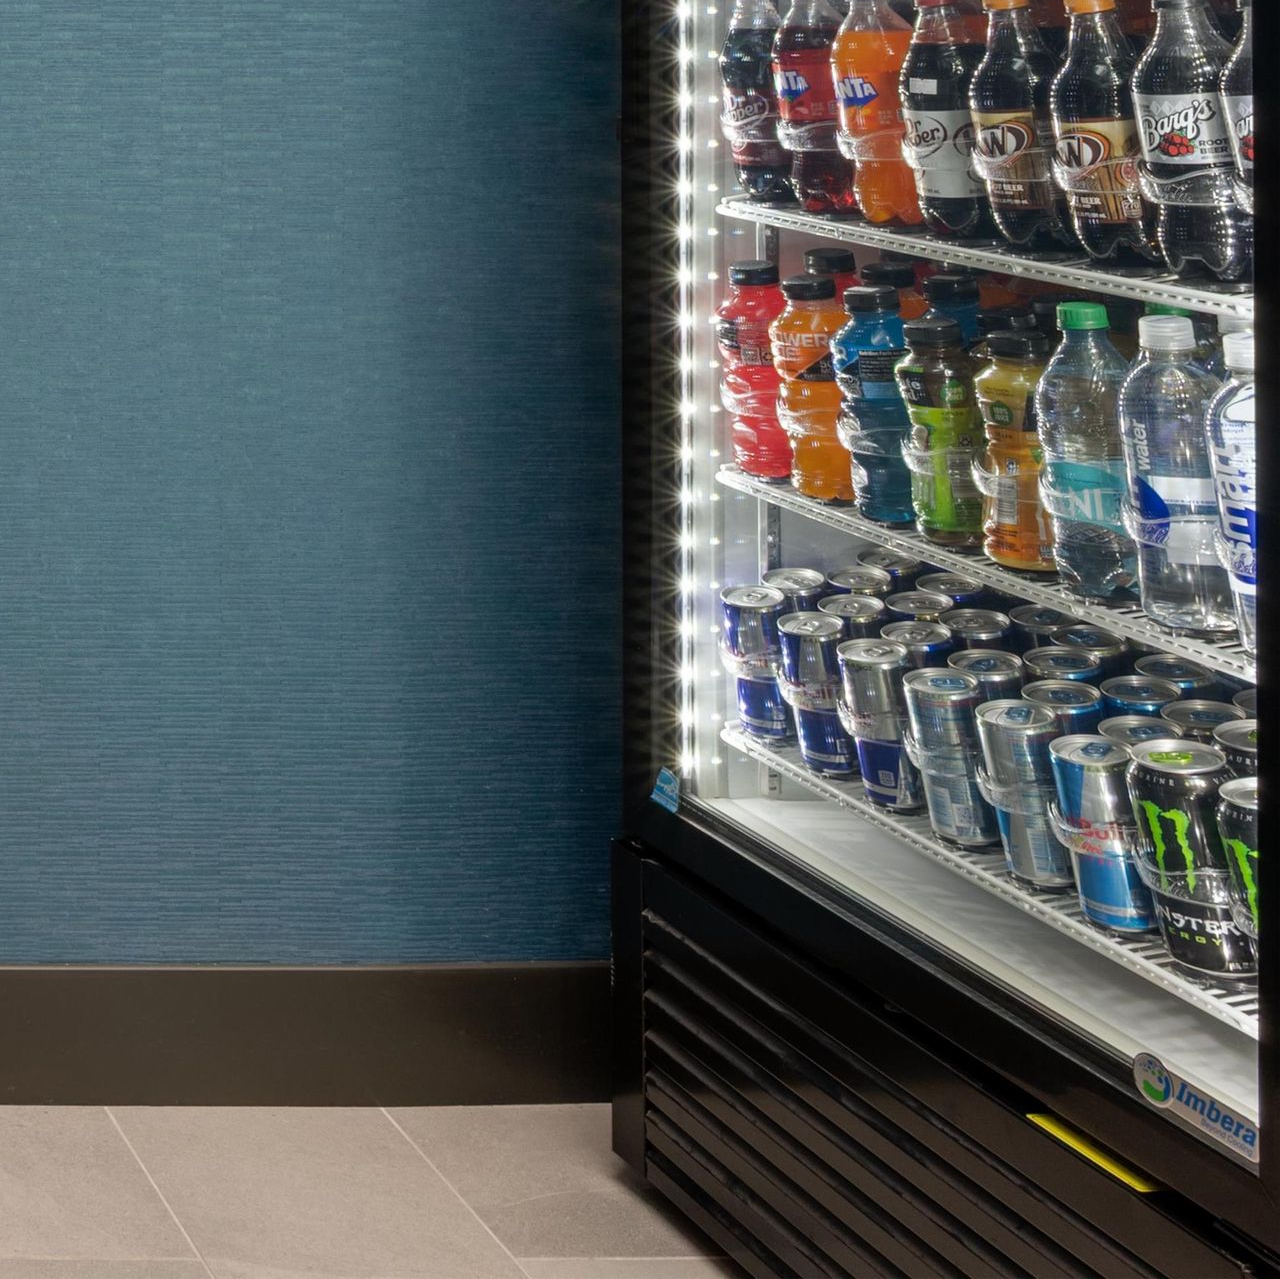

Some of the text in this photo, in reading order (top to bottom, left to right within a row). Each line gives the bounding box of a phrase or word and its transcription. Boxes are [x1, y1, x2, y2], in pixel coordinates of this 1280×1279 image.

[1140, 98, 1217, 151] Barq's
[1199, 139, 1228, 148] ROOT
[1200, 146, 1229, 154] BEER
[1005, 181, 1025, 192] BEER
[1176, 1082, 1257, 1147] Imbera
